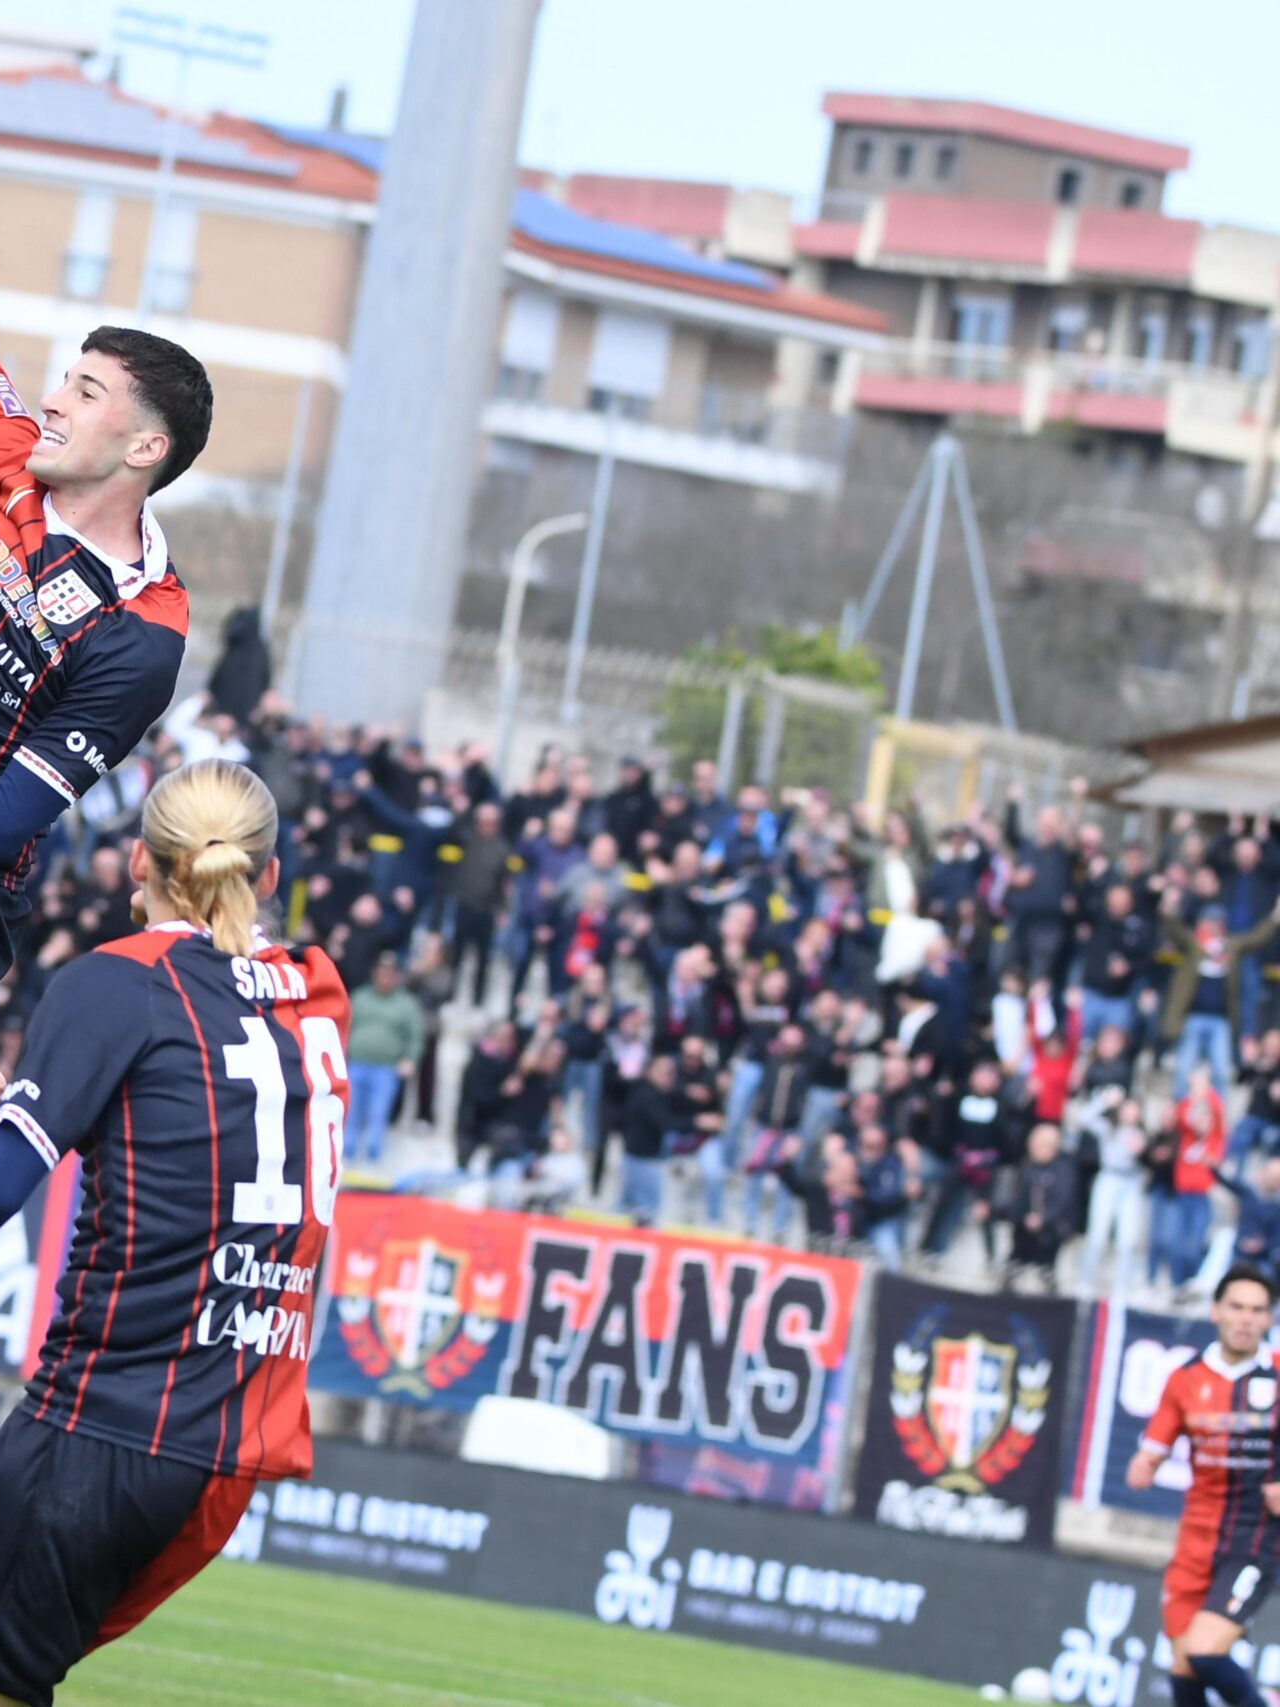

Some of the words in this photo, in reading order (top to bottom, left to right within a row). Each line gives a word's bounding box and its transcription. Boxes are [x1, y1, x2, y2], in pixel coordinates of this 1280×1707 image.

[1, 691, 21, 709] Srl
[230, 956, 308, 1000] SALA
[222, 1016, 348, 1227] 16
[496, 1228, 833, 1455] FANS
